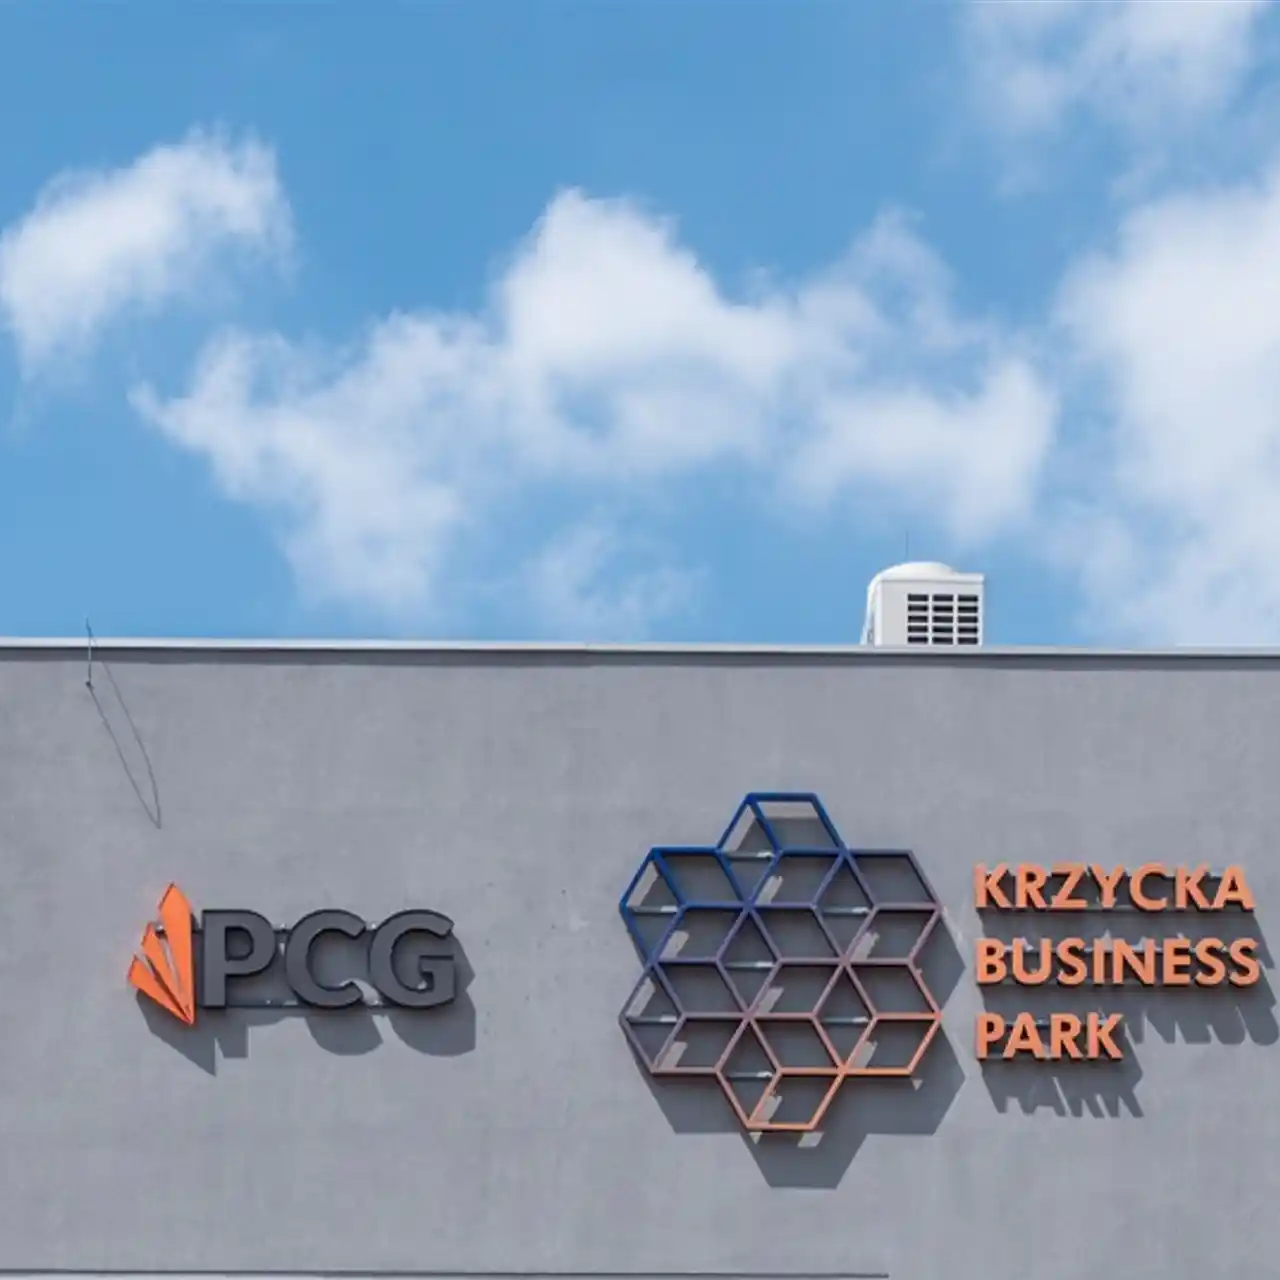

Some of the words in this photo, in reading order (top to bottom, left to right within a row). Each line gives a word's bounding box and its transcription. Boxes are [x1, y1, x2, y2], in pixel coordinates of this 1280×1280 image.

[973, 862, 1257, 911] KRZYCKA
[202, 908, 456, 1009] PCG
[974, 937, 1262, 987] BUSINESS
[974, 1012, 1125, 1061] PARK
